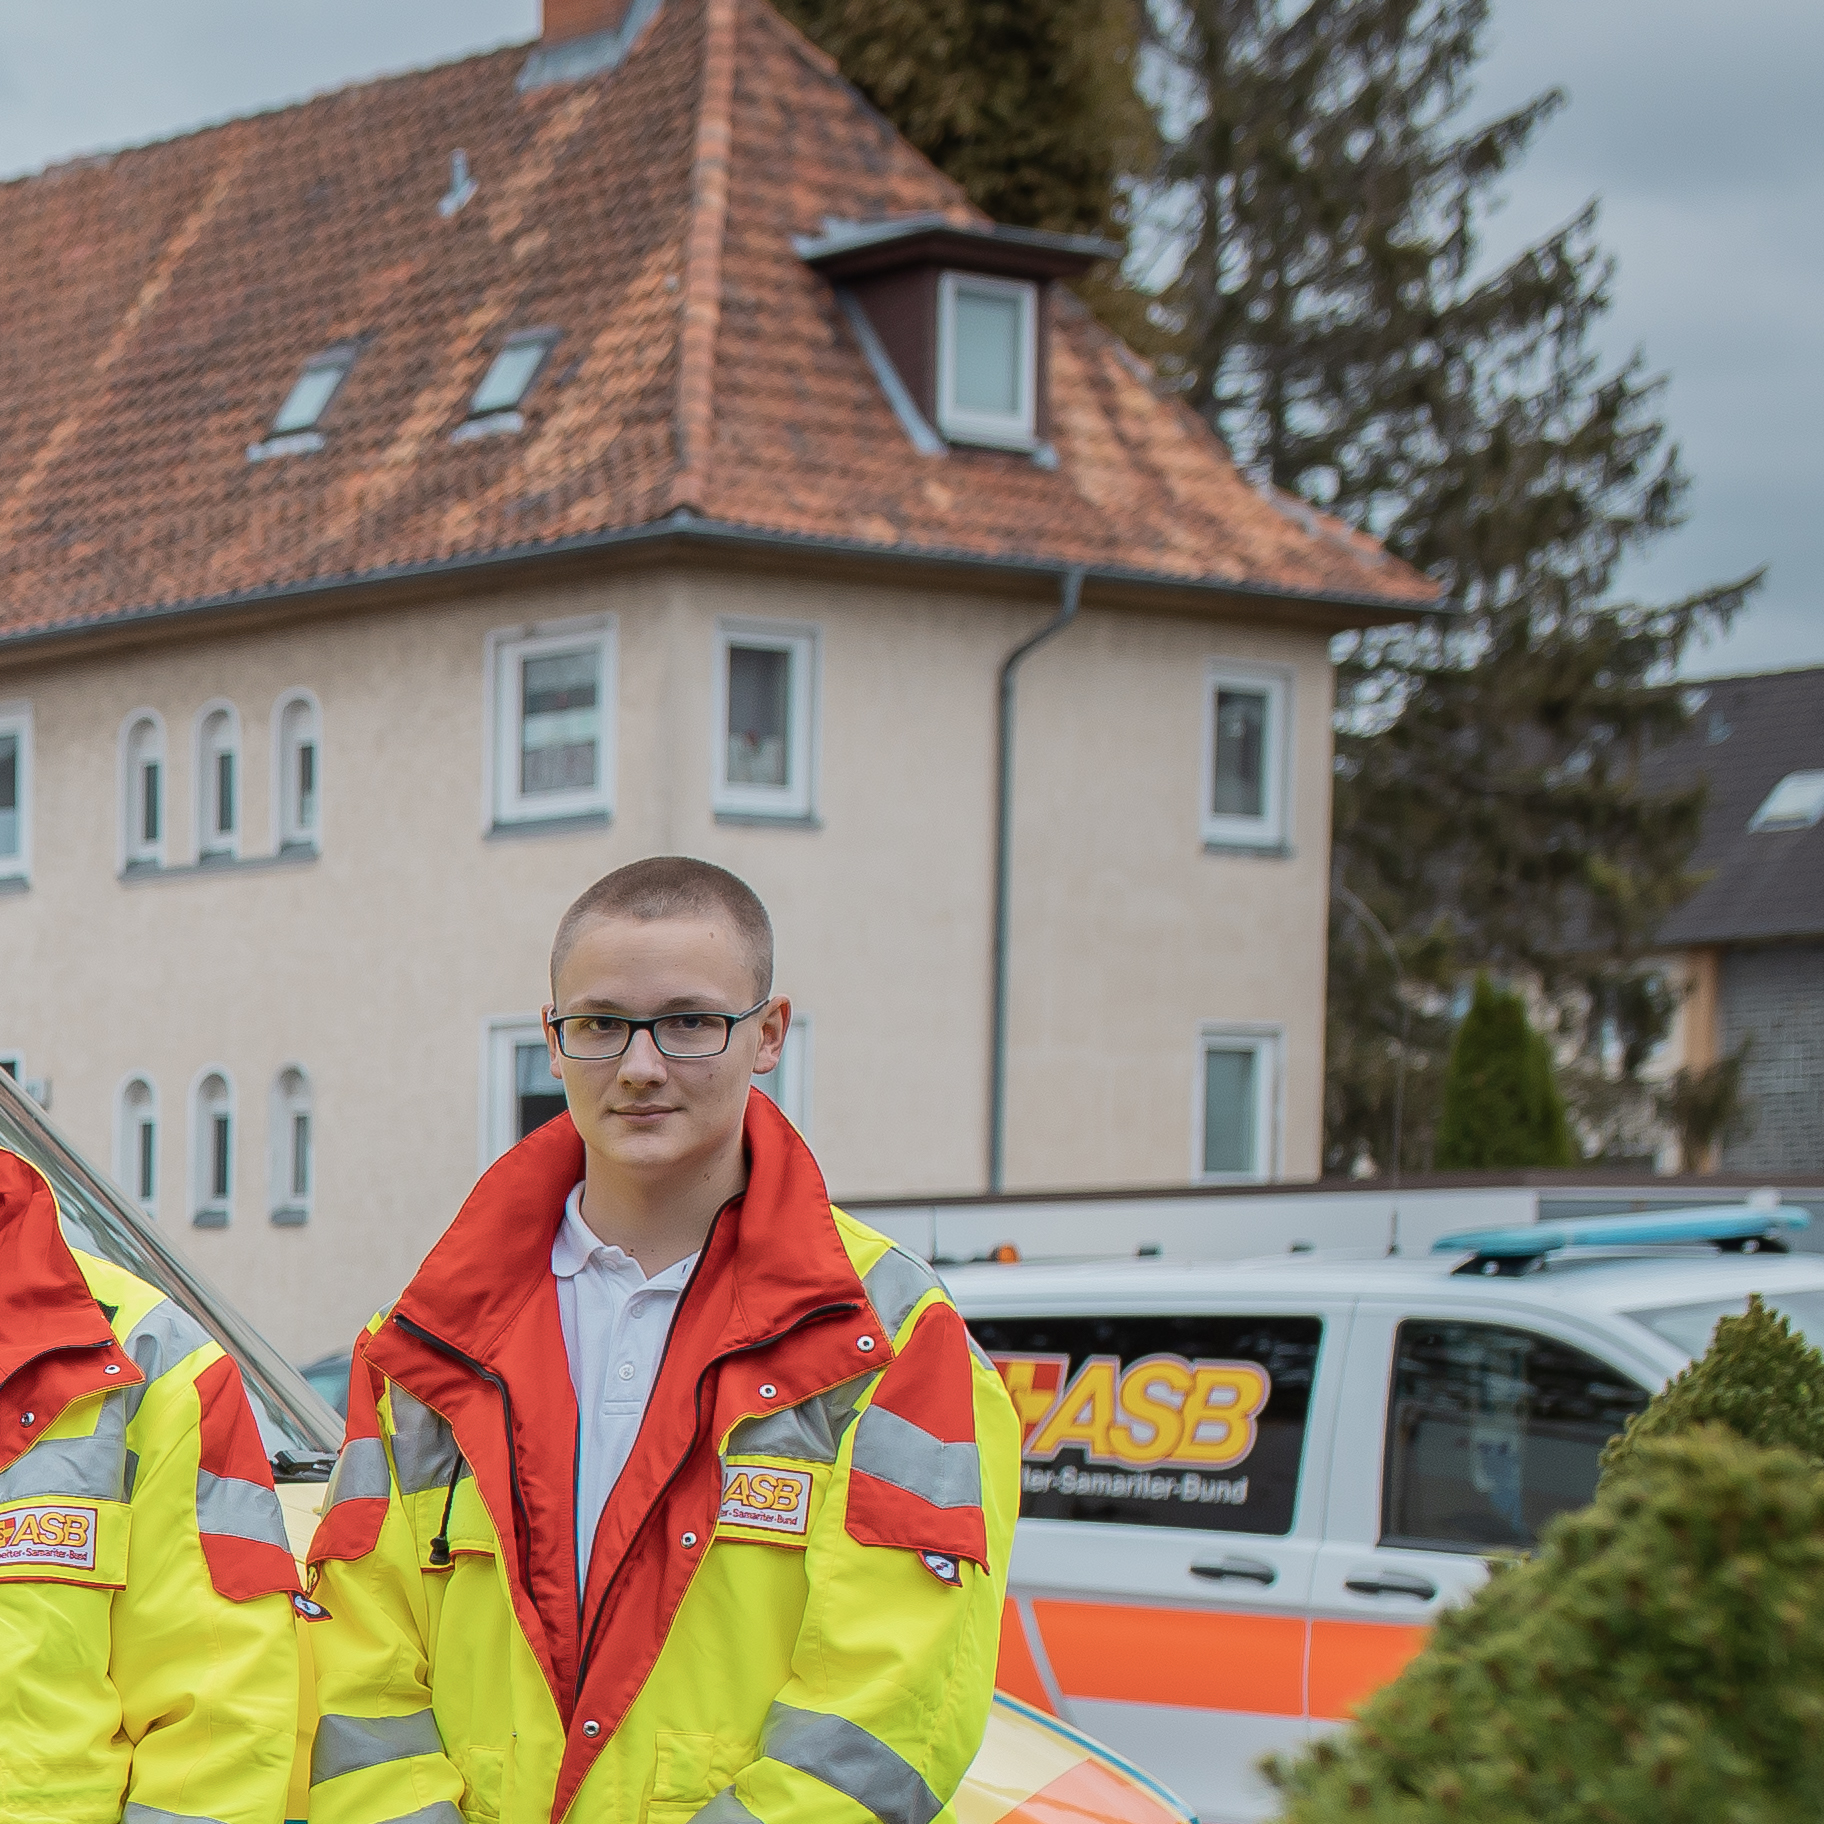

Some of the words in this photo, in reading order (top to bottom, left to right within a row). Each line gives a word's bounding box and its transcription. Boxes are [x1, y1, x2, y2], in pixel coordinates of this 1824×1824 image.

[1022, 1353, 1271, 1471] ASB
[723, 1472, 803, 1513] ASB
[10, 1511, 90, 1548] ASB
